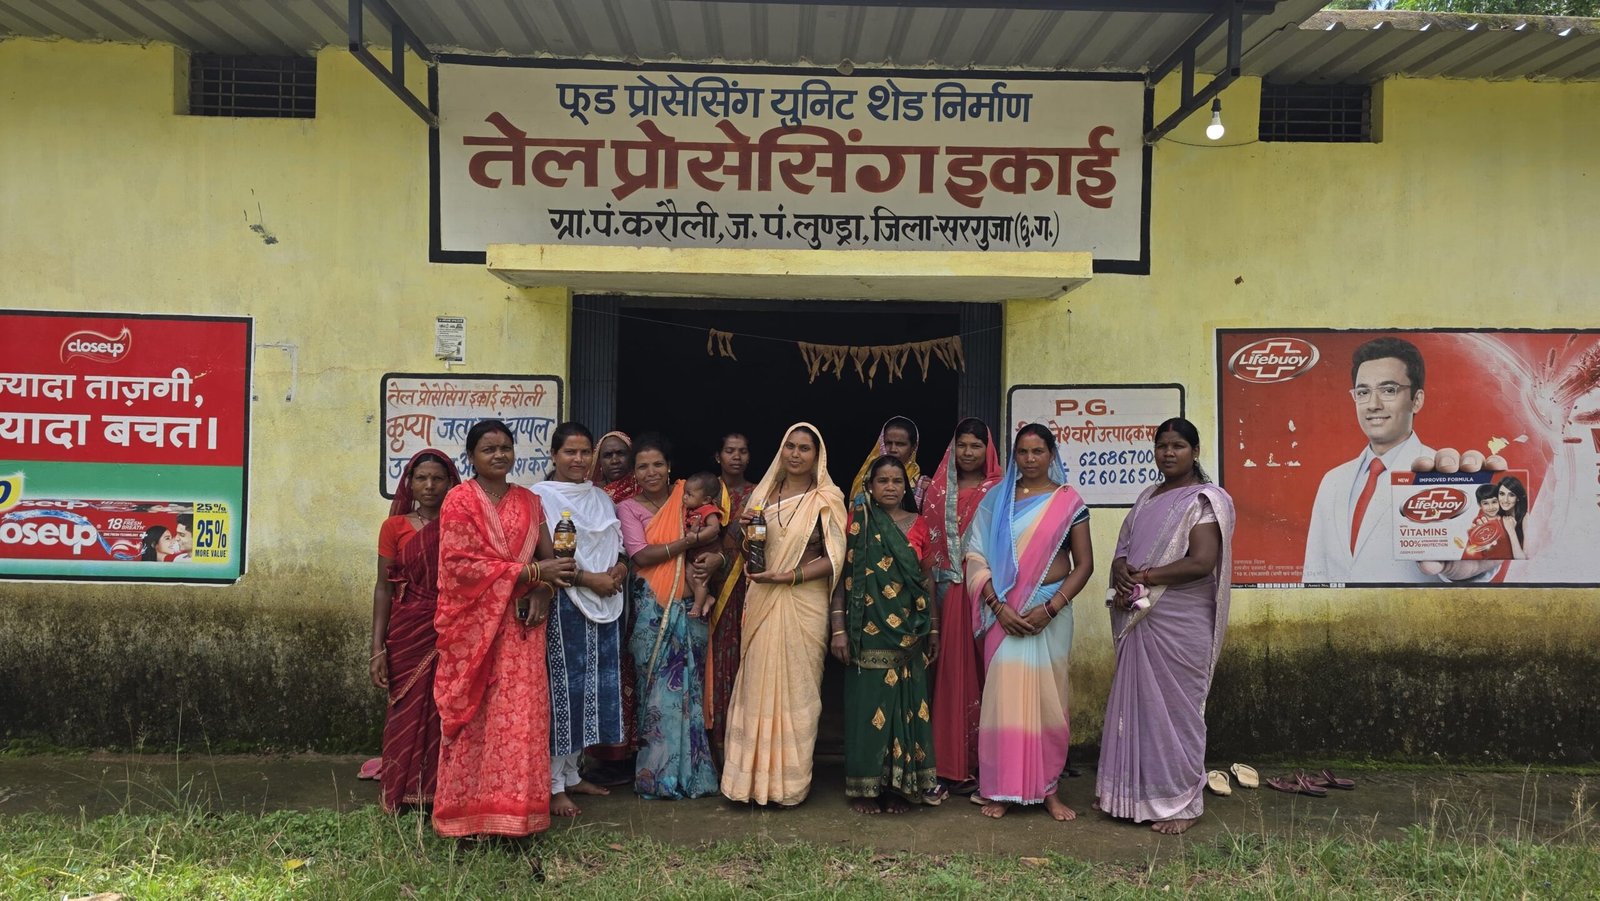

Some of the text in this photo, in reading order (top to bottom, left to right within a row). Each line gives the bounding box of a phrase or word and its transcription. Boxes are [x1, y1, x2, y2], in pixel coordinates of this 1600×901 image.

[556, 72, 1033, 128] फूड प्रोसेसिंग युनिट शेड निर्माण
[463, 112, 1120, 208] तेल प्रोसेसिंग इकाई
[67, 338, 124, 357] closeup
[1238, 352, 1308, 368] Lifebuoy
[85, 368, 204, 407] ताज़गी,
[387, 381, 547, 411] तेल प्रोसेसिंग इकाई करौली
[1056, 399, 1114, 416] P.G.
[0, 412, 217, 449] यादा बचत।
[1097, 424, 1145, 445] उत्पादक
[1079, 449, 1154, 467] 62686700
[196, 503, 226, 512] 25%
[1408, 499, 1463, 511] Lifebuoy
[107, 518, 123, 530] 18
[1399, 528, 1448, 537] VITAMINS
[0, 523, 97, 555] oseup
[196, 519, 227, 548] 25%
[1400, 539, 1422, 548] 100%
[195, 549, 226, 558] MORE VALUE
